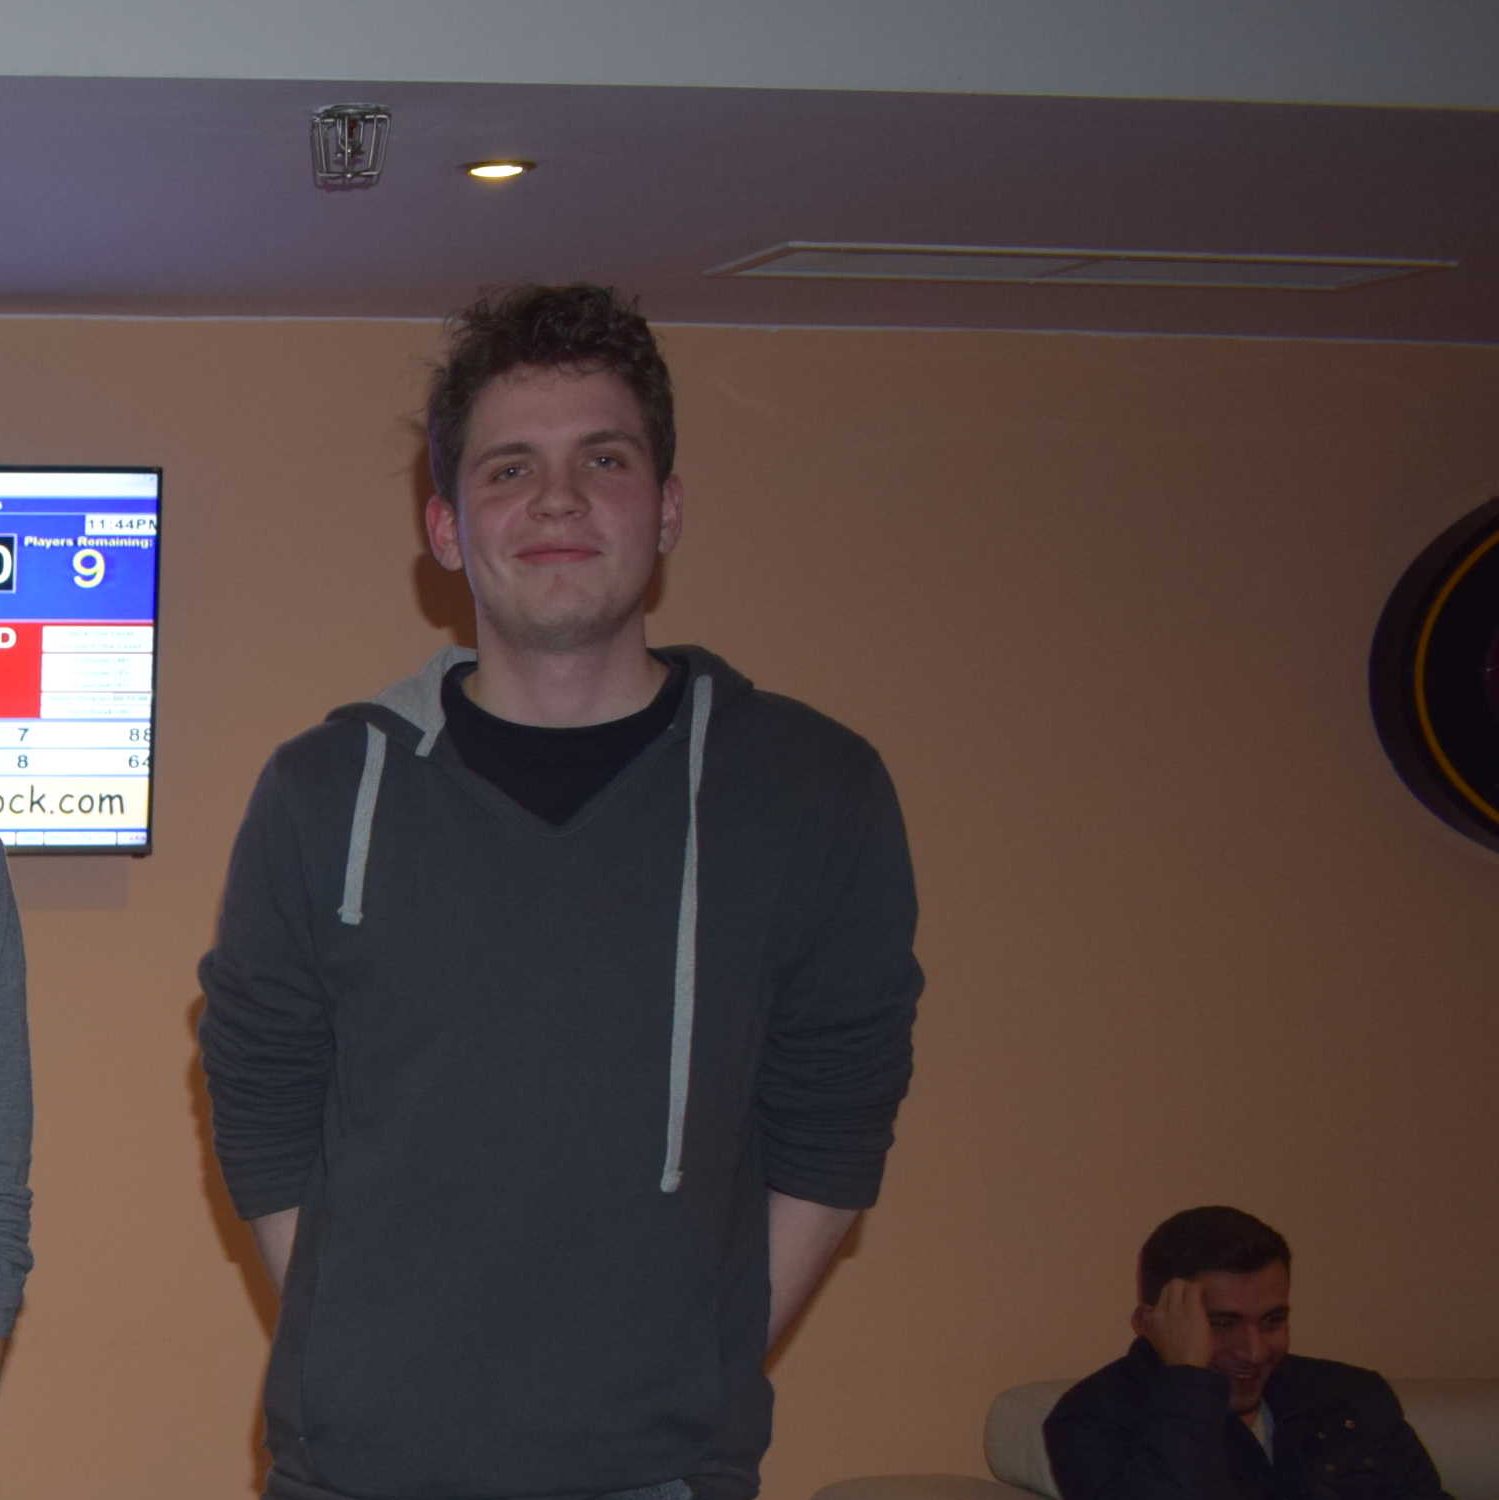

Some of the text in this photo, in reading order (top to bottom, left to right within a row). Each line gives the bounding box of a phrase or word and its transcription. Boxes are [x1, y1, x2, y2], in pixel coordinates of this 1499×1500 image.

[24, 535, 153, 549] Players Remaining:
[72, 548, 106, 589] 9
[17, 727, 29, 742] 7
[17, 754, 28, 769] 8
